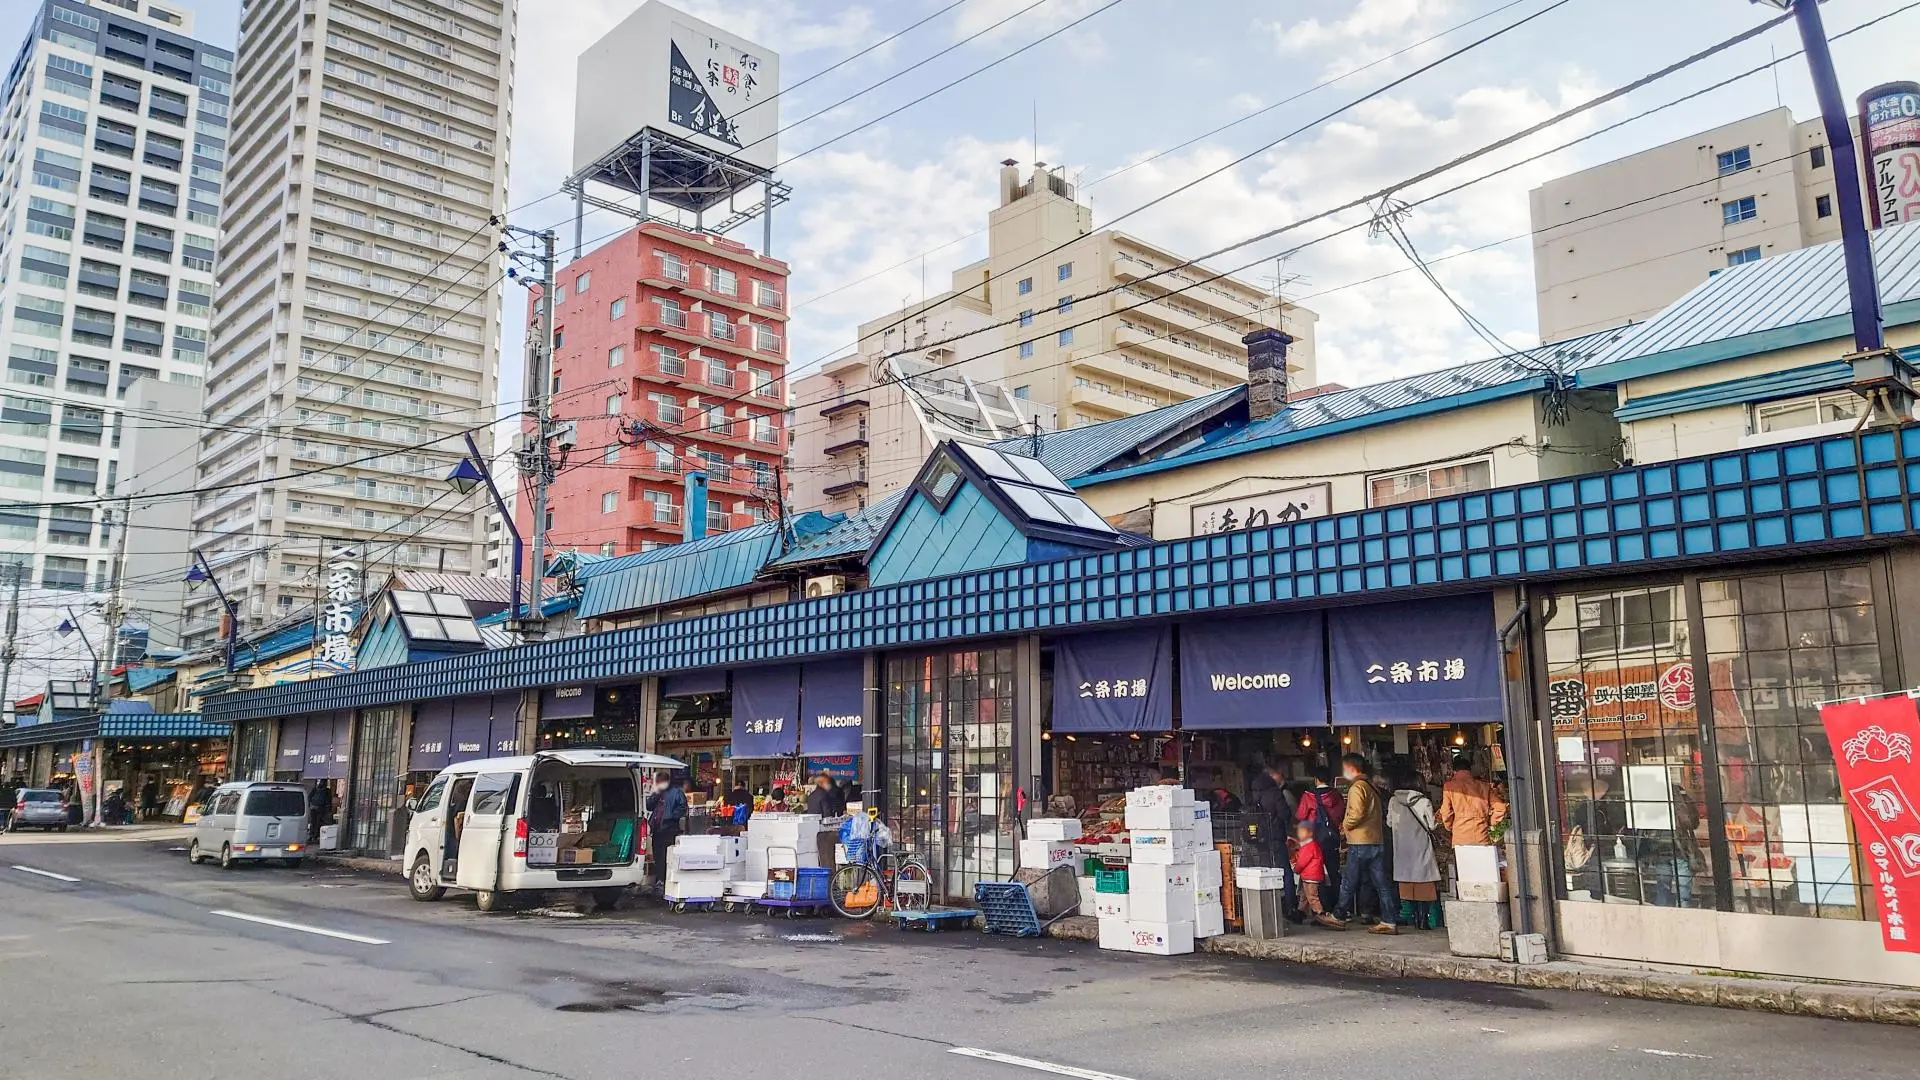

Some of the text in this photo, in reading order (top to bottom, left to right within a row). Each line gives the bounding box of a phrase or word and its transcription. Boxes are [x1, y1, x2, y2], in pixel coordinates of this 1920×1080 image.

[671, 109, 683, 123] BF
[1876, 158, 1899, 226] アルファコ
[322, 544, 359, 662] 二条市場
[1365, 658, 1466, 685] 二条市場
[1078, 678, 1147, 700] 二条市場
[1211, 671, 1291, 692] Welcome
[555, 687, 582, 699] Welcome
[745, 717, 784, 734] 二条市場
[817, 714, 862, 729] Welcome
[458, 742, 480, 752] Welcome
